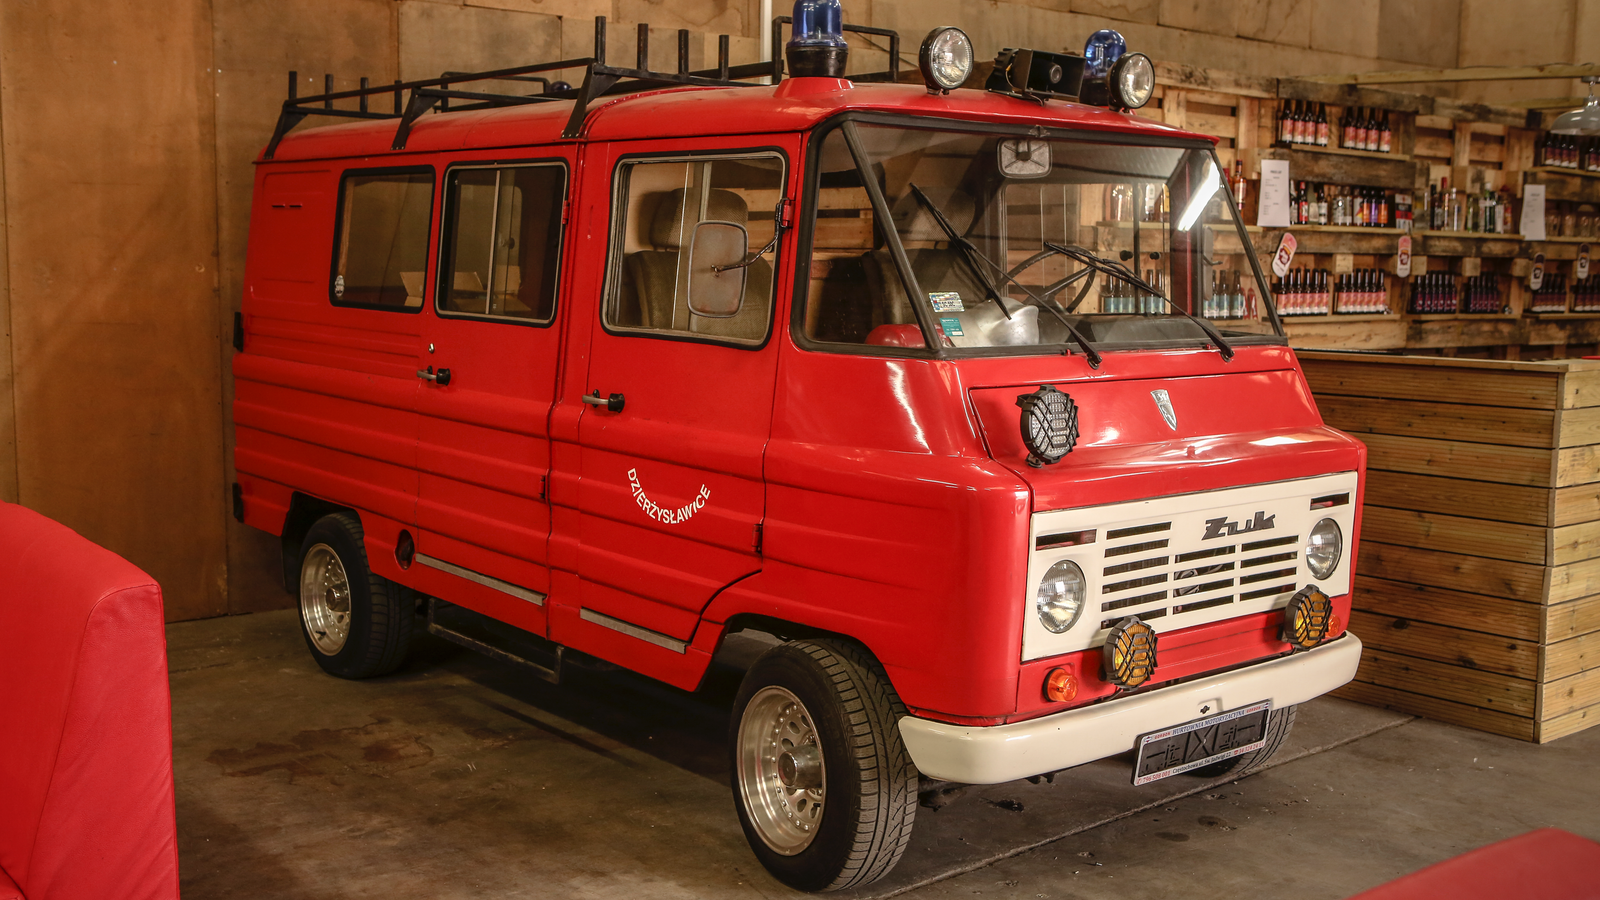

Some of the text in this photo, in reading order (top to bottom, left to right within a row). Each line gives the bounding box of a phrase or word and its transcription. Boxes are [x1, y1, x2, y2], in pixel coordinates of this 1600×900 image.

[627, 467, 711, 524] DZIERŻYSŁAWICE
[1172, 722, 1204, 735] HURTOWNIA
[1204, 710, 1245, 726] MOTORYZACYJNA
